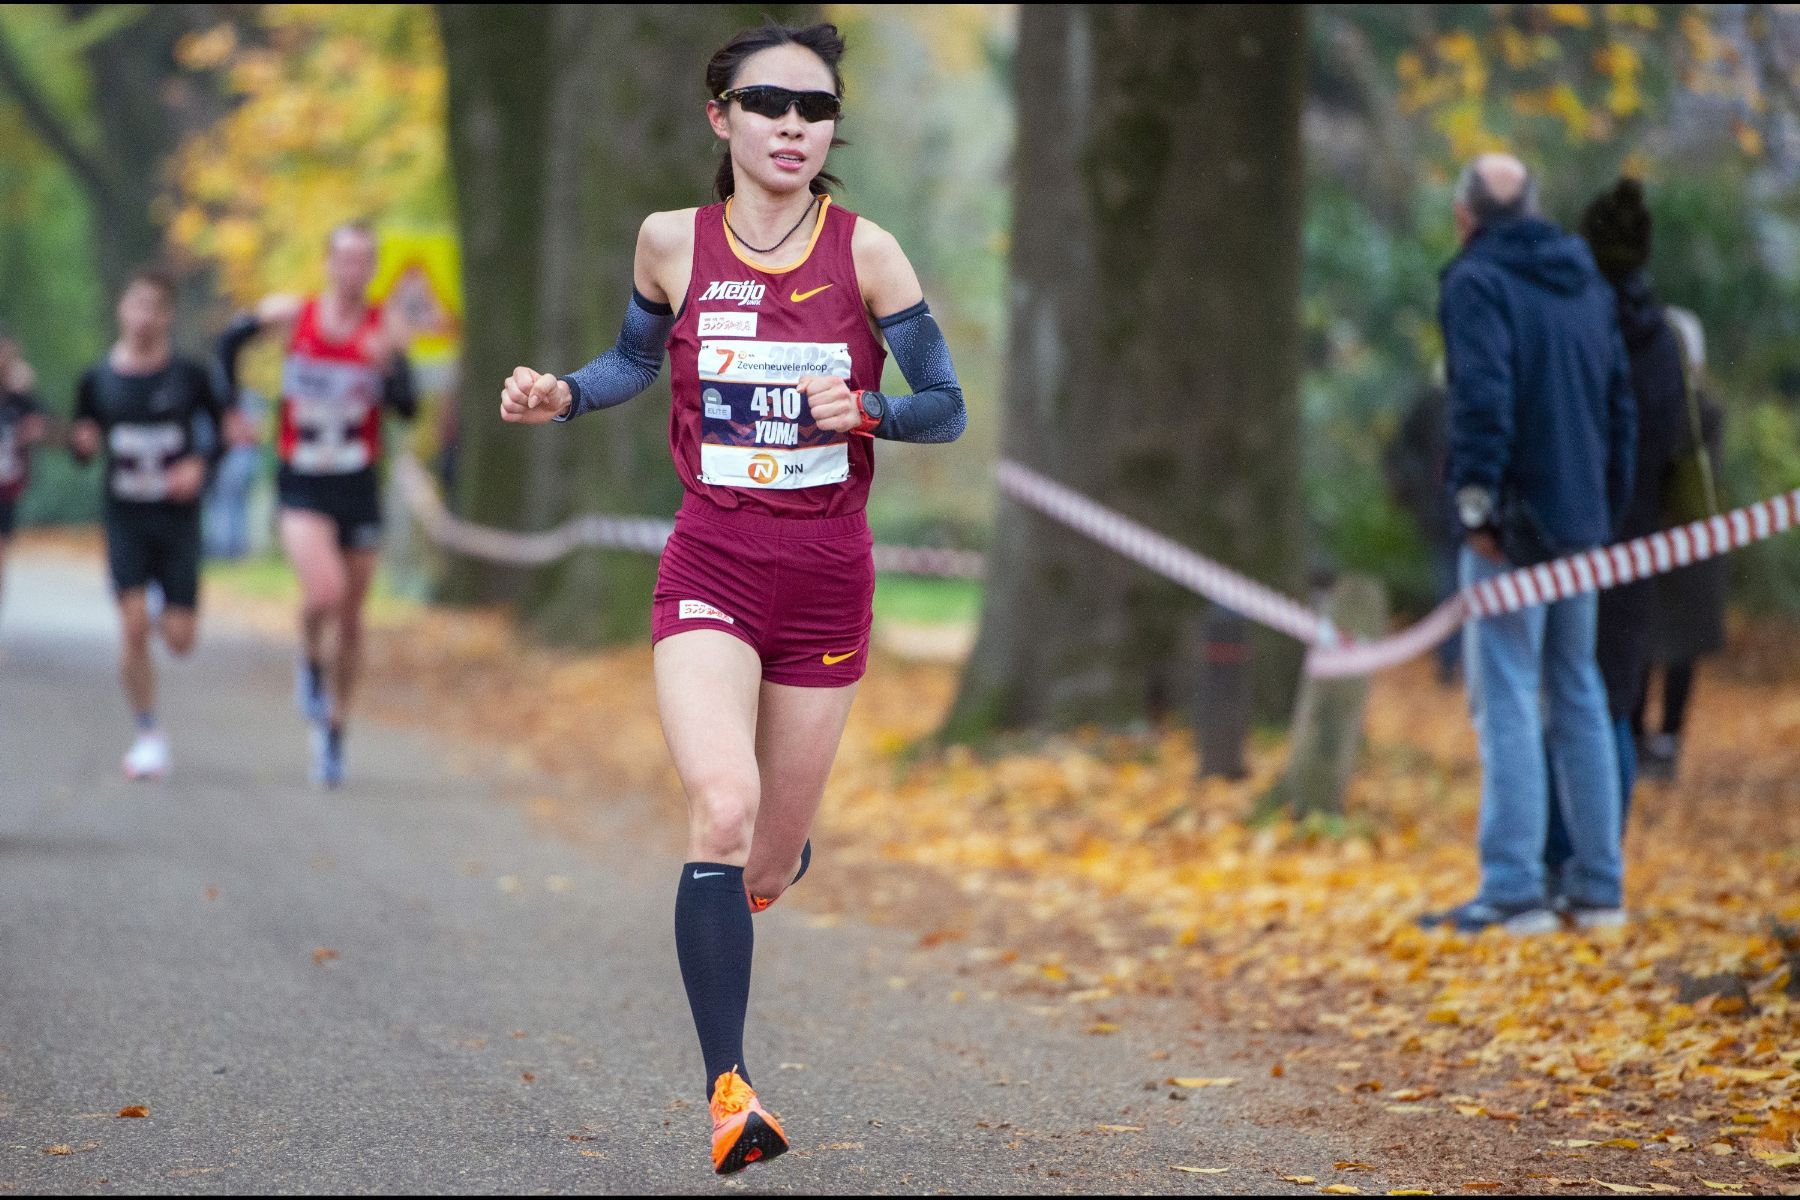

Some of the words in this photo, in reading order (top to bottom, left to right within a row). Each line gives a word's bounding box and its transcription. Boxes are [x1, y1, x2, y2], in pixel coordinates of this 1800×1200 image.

[699, 280, 766, 306] Meijo
[716, 349, 735, 375] 7
[737, 361, 828, 373] Zevenheuvelenloop
[707, 407, 728, 416] ELITE
[751, 387, 800, 419] 410
[755, 420, 799, 445] YUMA
[784, 463, 804, 475] NN
